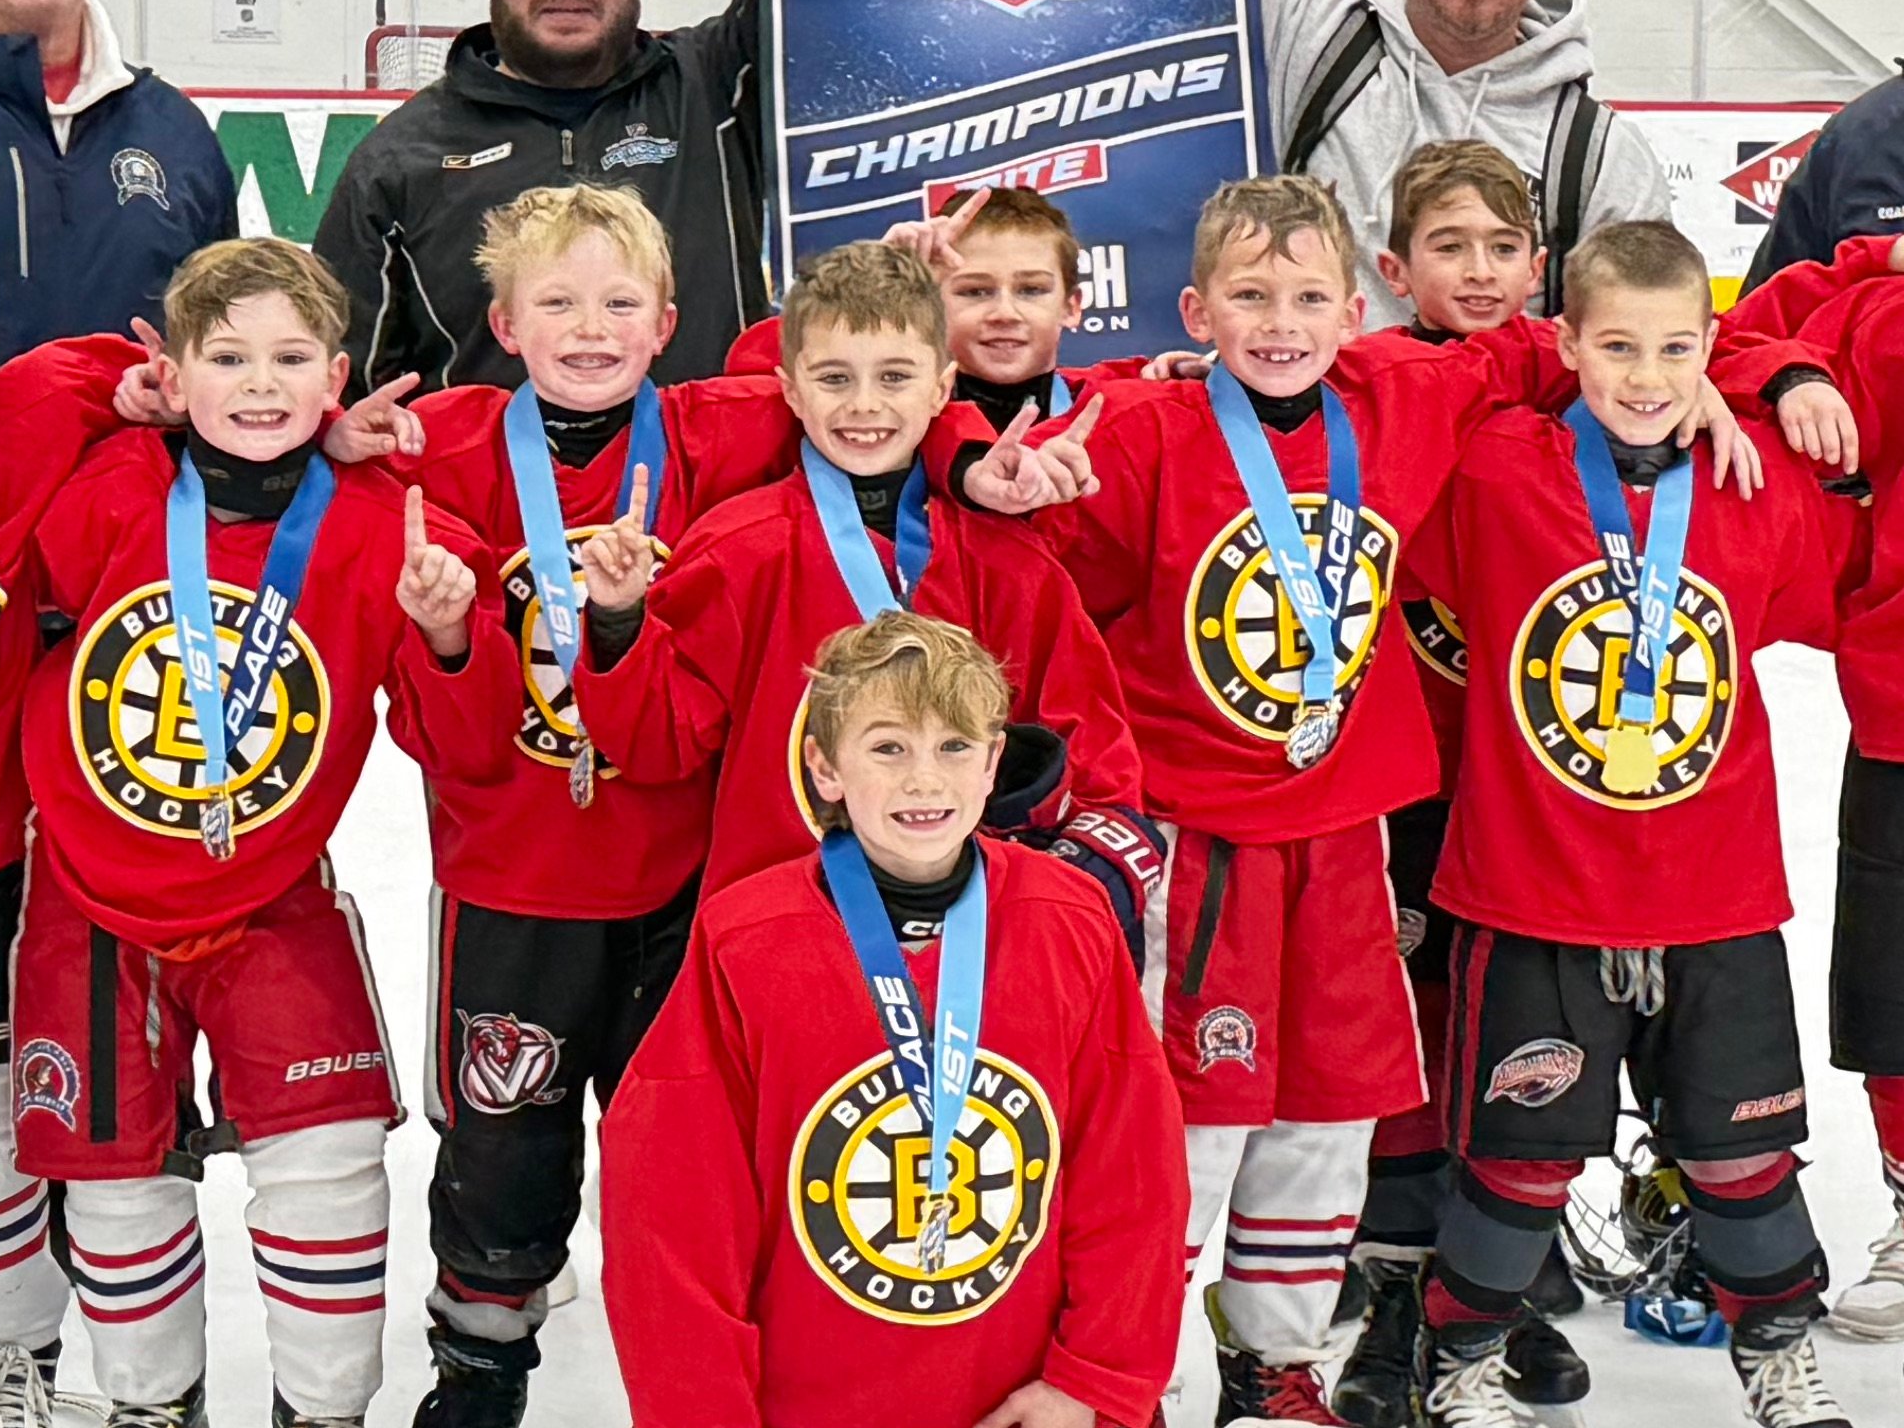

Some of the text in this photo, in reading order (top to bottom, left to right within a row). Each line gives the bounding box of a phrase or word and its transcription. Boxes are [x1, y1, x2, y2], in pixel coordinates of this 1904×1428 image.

[804, 52, 1231, 190] CHAMPIONS
[226, 584, 289, 737] PLACE
[93, 746, 291, 823] HOCEY
[828, 1222, 1030, 1310] HOCKEY
